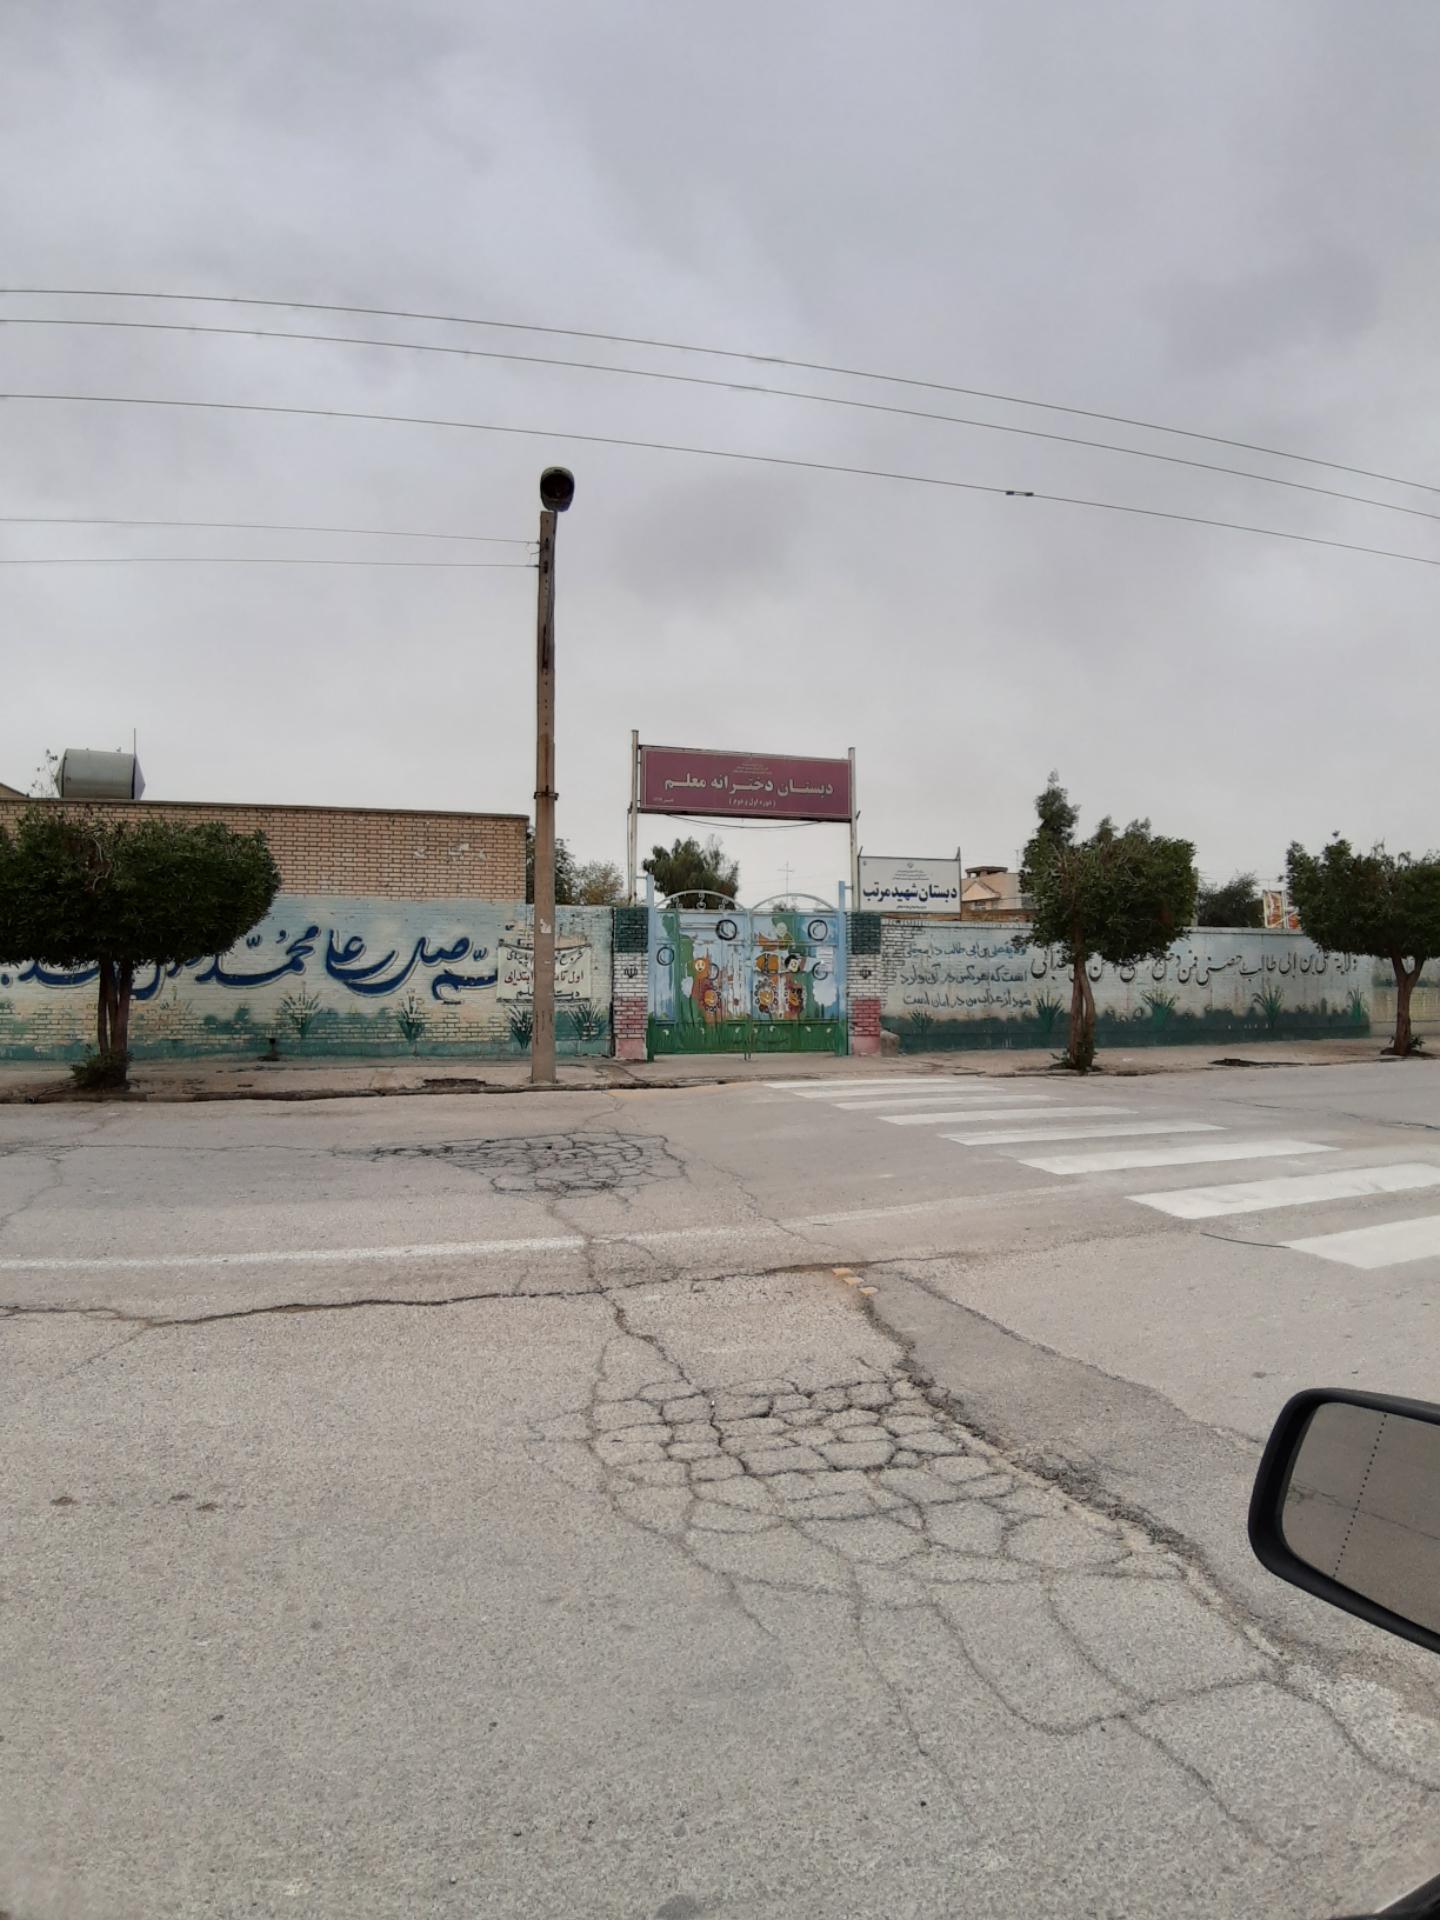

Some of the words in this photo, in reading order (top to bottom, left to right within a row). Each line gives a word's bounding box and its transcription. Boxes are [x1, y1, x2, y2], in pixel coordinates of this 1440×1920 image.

[664, 773, 707, 790] معلم
[711, 775, 774, 794] دخترانه
[777, 779, 834, 798] دبستان
[891, 883, 919, 903] شهید
[918, 884, 958, 903] دبستان
